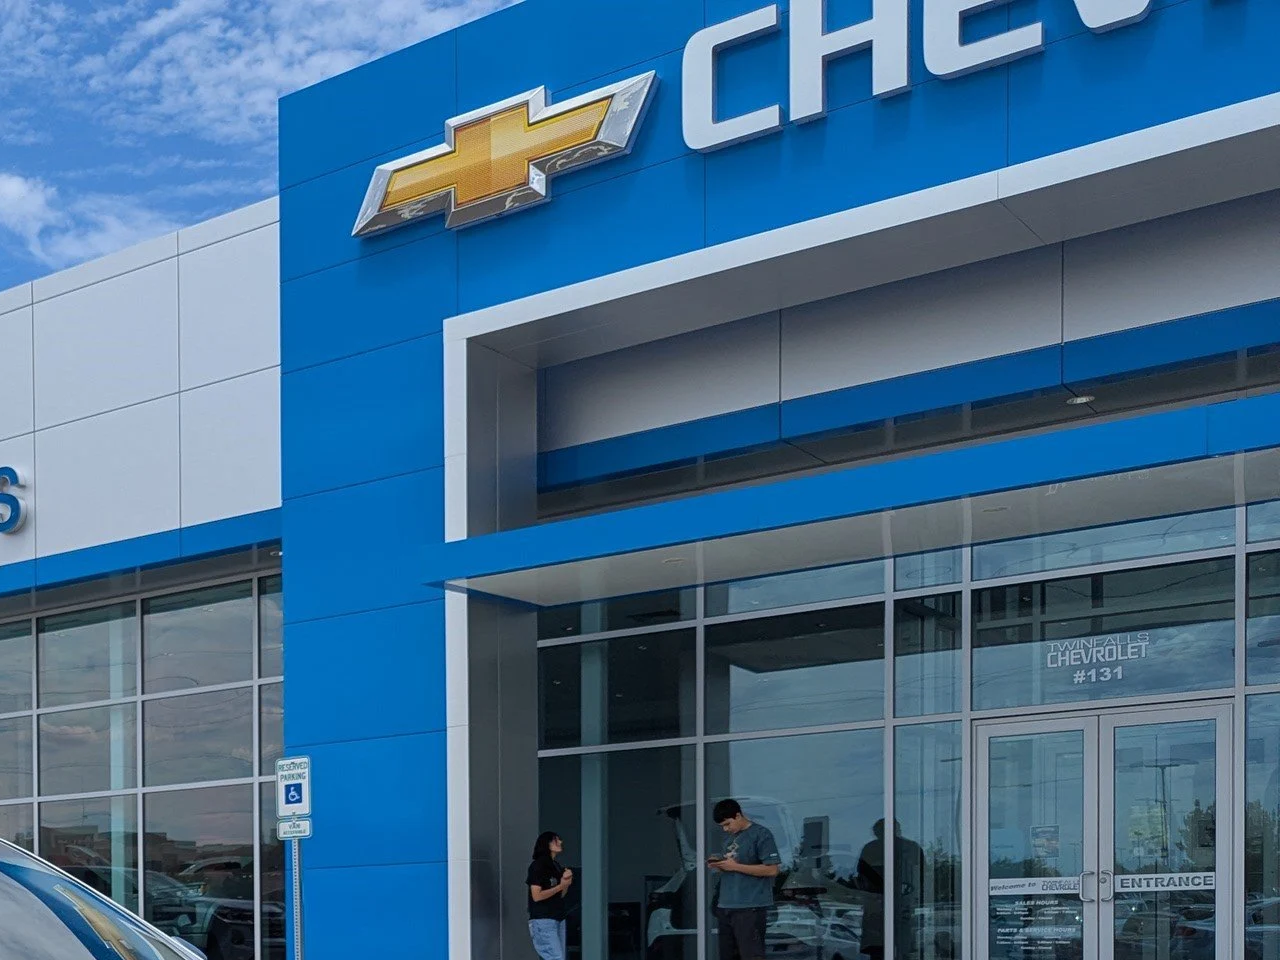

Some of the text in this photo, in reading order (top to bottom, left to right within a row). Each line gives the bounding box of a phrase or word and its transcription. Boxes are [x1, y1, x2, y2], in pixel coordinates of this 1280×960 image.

[682, 0, 1152, 153] CHE
[1046, 641, 1150, 668] CHEVROLET
[1073, 666, 1123, 684] #131
[278, 761, 308, 772] RESERVED
[280, 772, 306, 782] PARKING
[990, 882, 1026, 891] Welcome
[1041, 883, 1080, 891] CHEVROLE
[1120, 875, 1214, 888] ENTRANCE
